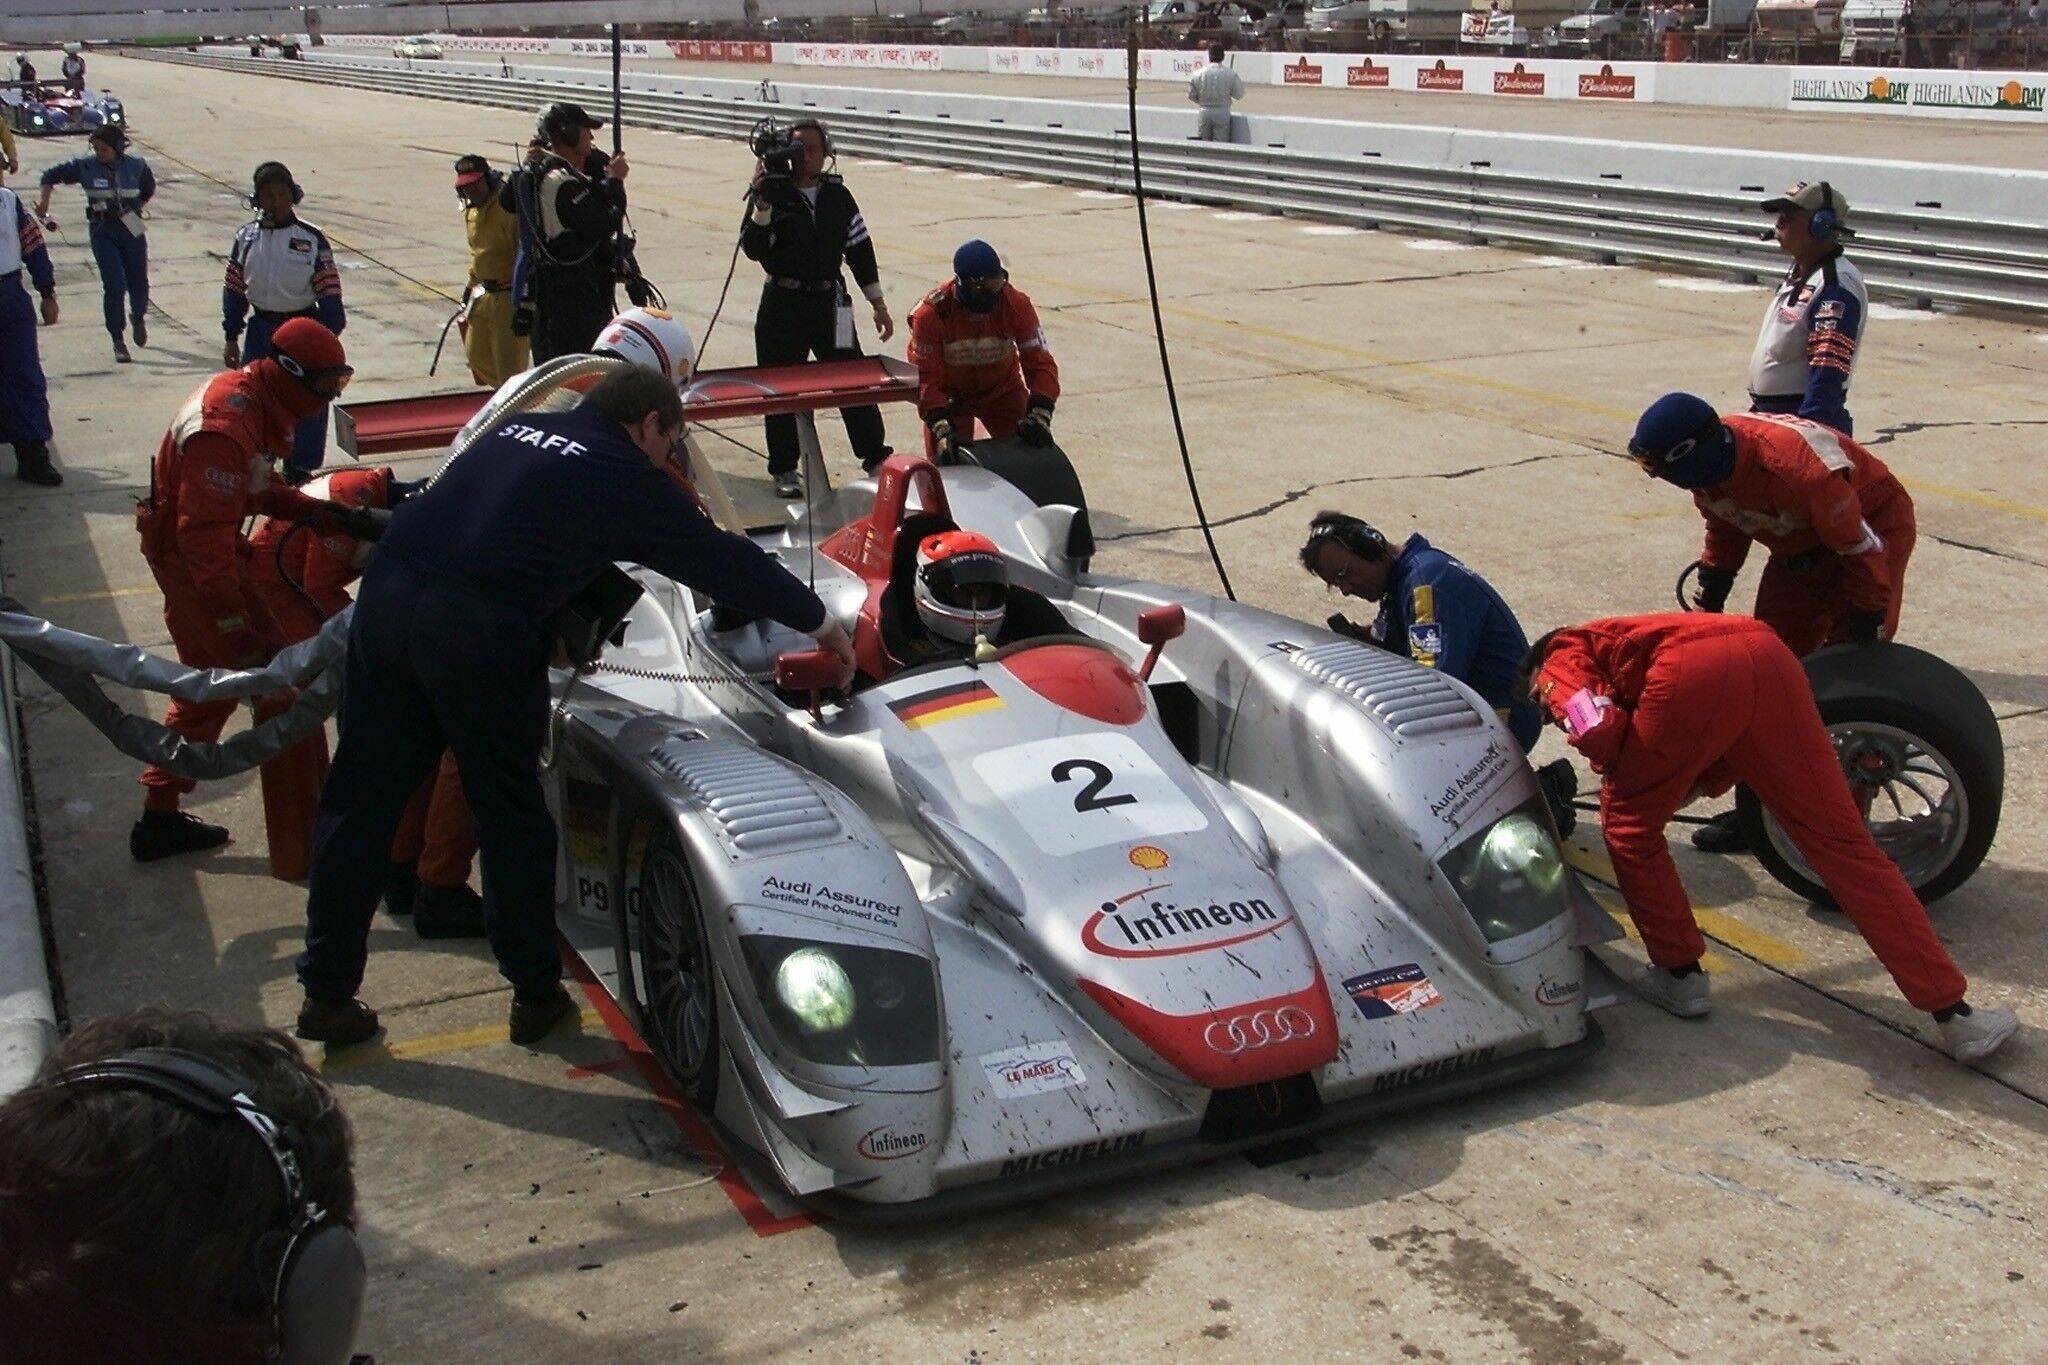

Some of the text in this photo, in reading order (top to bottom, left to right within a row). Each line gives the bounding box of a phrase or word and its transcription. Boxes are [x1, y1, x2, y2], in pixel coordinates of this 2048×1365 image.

[1494, 74, 1543, 90] Budweiser
[1580, 78, 1634, 94] Budweiser
[1793, 79, 1862, 98] HIGHLANDS
[1913, 82, 1992, 104] HIGHLANDS
[498, 424, 588, 456] STAFF
[1051, 759, 1138, 813] 2
[1430, 741, 1500, 817] Audi Assured
[761, 889, 898, 928] Certified Pre-Owned Cars
[763, 876, 901, 917] Audi Assured
[1112, 898, 1277, 945] Infineon
[1006, 1064, 1055, 1083] LE MANS
[869, 1133, 926, 1153] Infineon
[1000, 1130, 1147, 1177] MICHELIN
